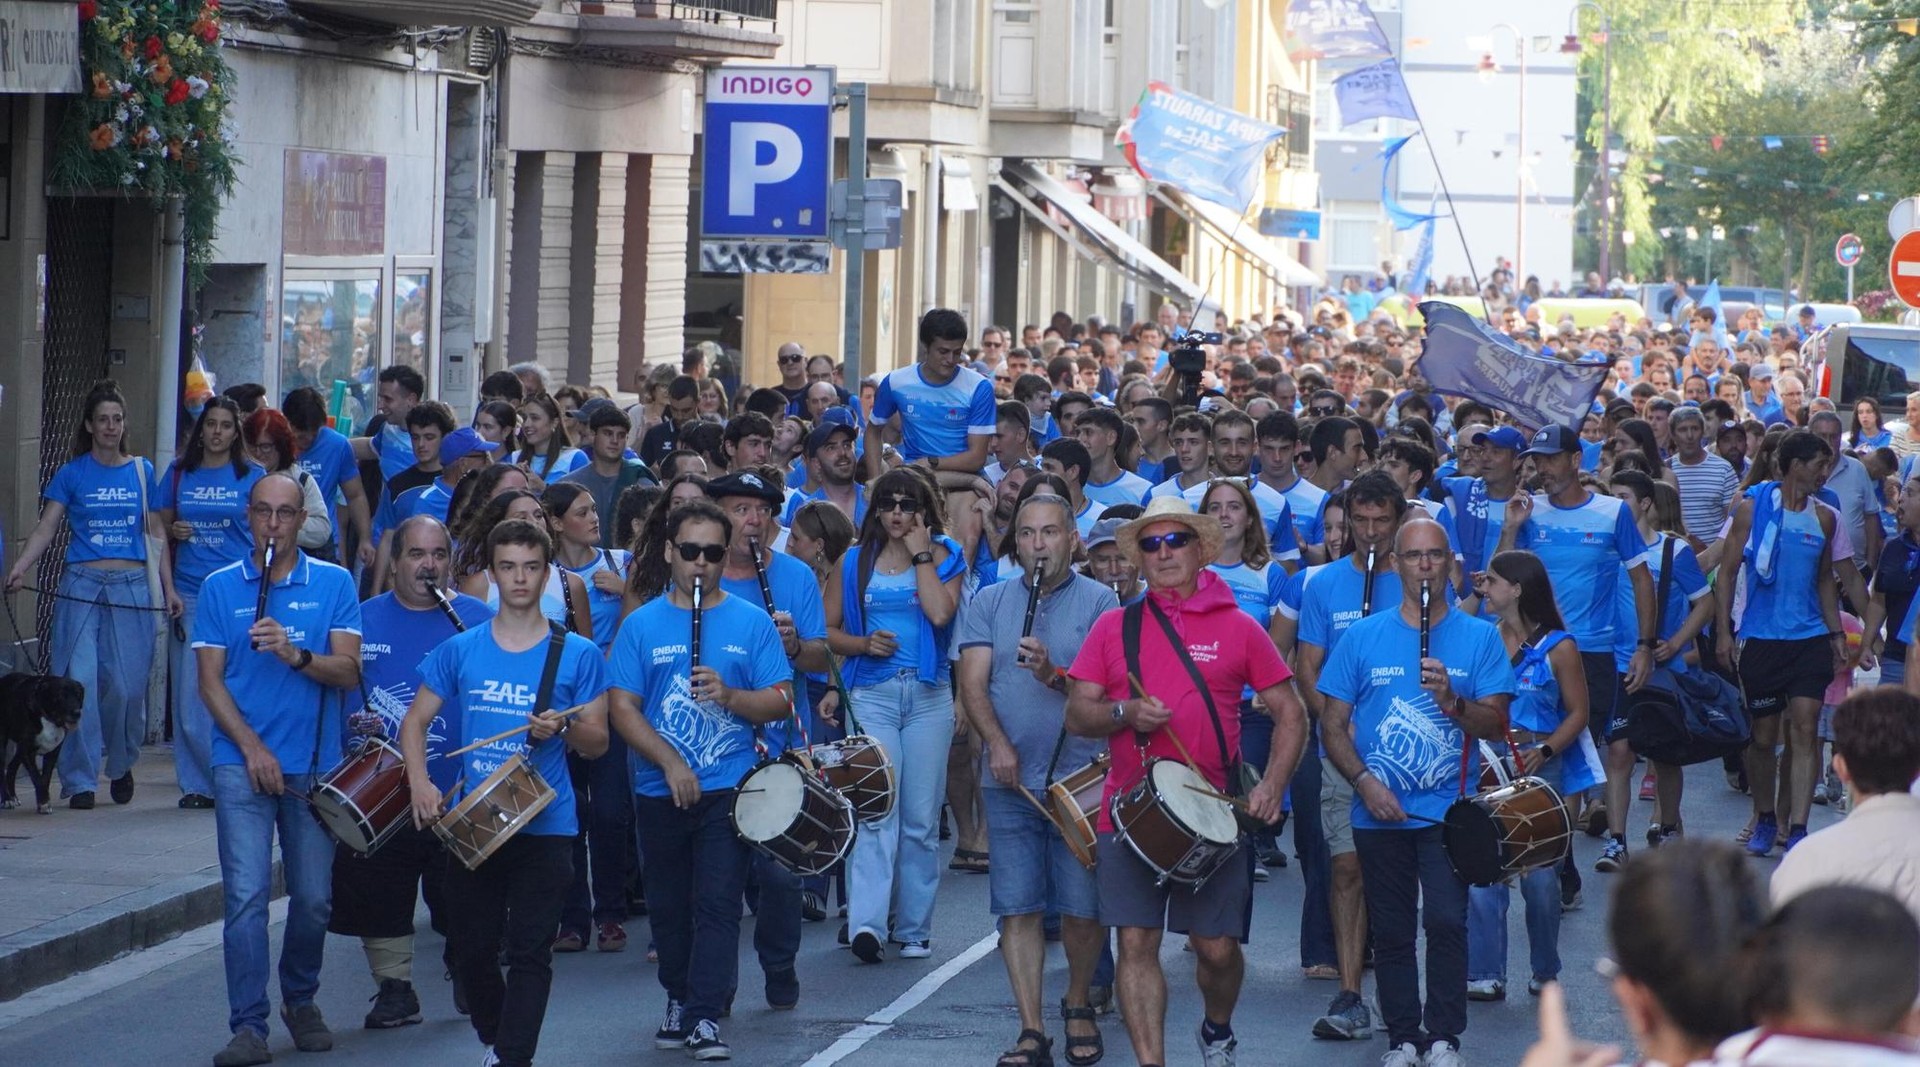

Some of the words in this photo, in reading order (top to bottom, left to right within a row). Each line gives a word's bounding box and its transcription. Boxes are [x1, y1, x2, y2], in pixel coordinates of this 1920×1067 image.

[722, 76, 813, 97] INDIGO
[728, 121, 804, 217] P
[1333, 610, 1363, 621] ENBATA
[360, 643, 392, 655] ENBATA
[652, 644, 688, 657] ENBATA
[652, 655, 675, 665] dator
[1371, 666, 1405, 678] ENBATA
[1371, 677, 1392, 687] dator
[482, 680, 529, 706] ZAE
